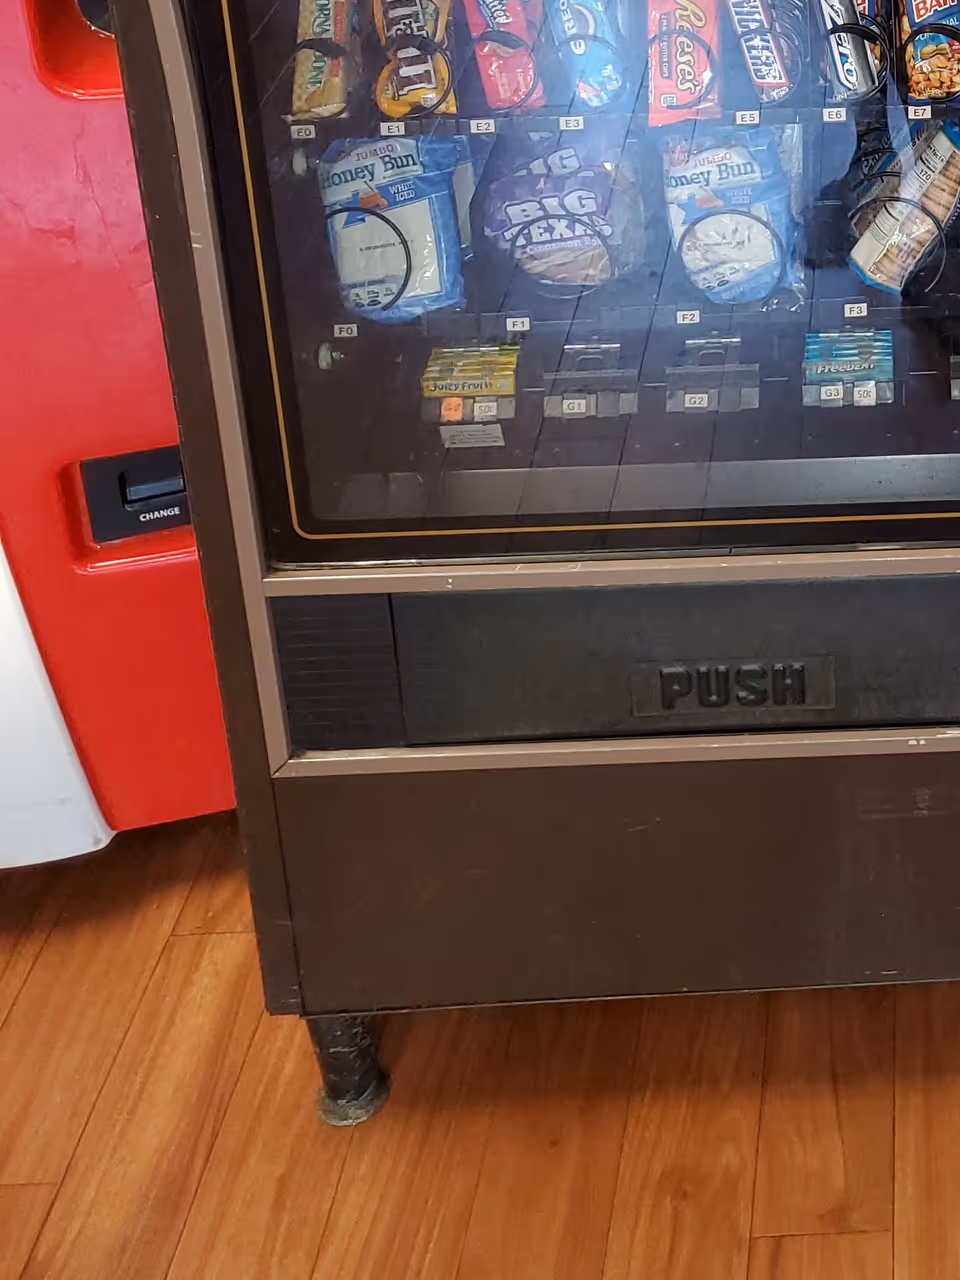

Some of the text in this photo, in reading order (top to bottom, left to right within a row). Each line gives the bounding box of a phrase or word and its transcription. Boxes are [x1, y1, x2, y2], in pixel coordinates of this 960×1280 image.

[741, 113, 755, 122] E5
[828, 111, 842, 120] E6
[913, 108, 927, 118] E7
[387, 125, 400, 134] E1
[477, 122, 491, 131] E2
[565, 120, 580, 129] E3
[297, 128, 312, 138] E0
[354, 144, 395, 162] JUMBO
[379, 151, 418, 174] Bun
[718, 161, 756, 180] Bun
[918, 168, 933, 182] 170
[395, 189, 416, 202] ICED
[505, 188, 599, 227] BIG
[503, 215, 614, 247] TEXAS
[527, 239, 583, 254] Cinnamon
[849, 306, 863, 315] F3
[682, 312, 696, 322] F2
[512, 320, 525, 329] F1
[338, 326, 353, 336] F0
[429, 379, 459, 392] Juicy
[825, 387, 840, 397] G3
[688, 396, 704, 405] G2
[567, 401, 582, 411] G1
[139, 506, 181, 521] CHANGE
[659, 662, 807, 710] PUSH
